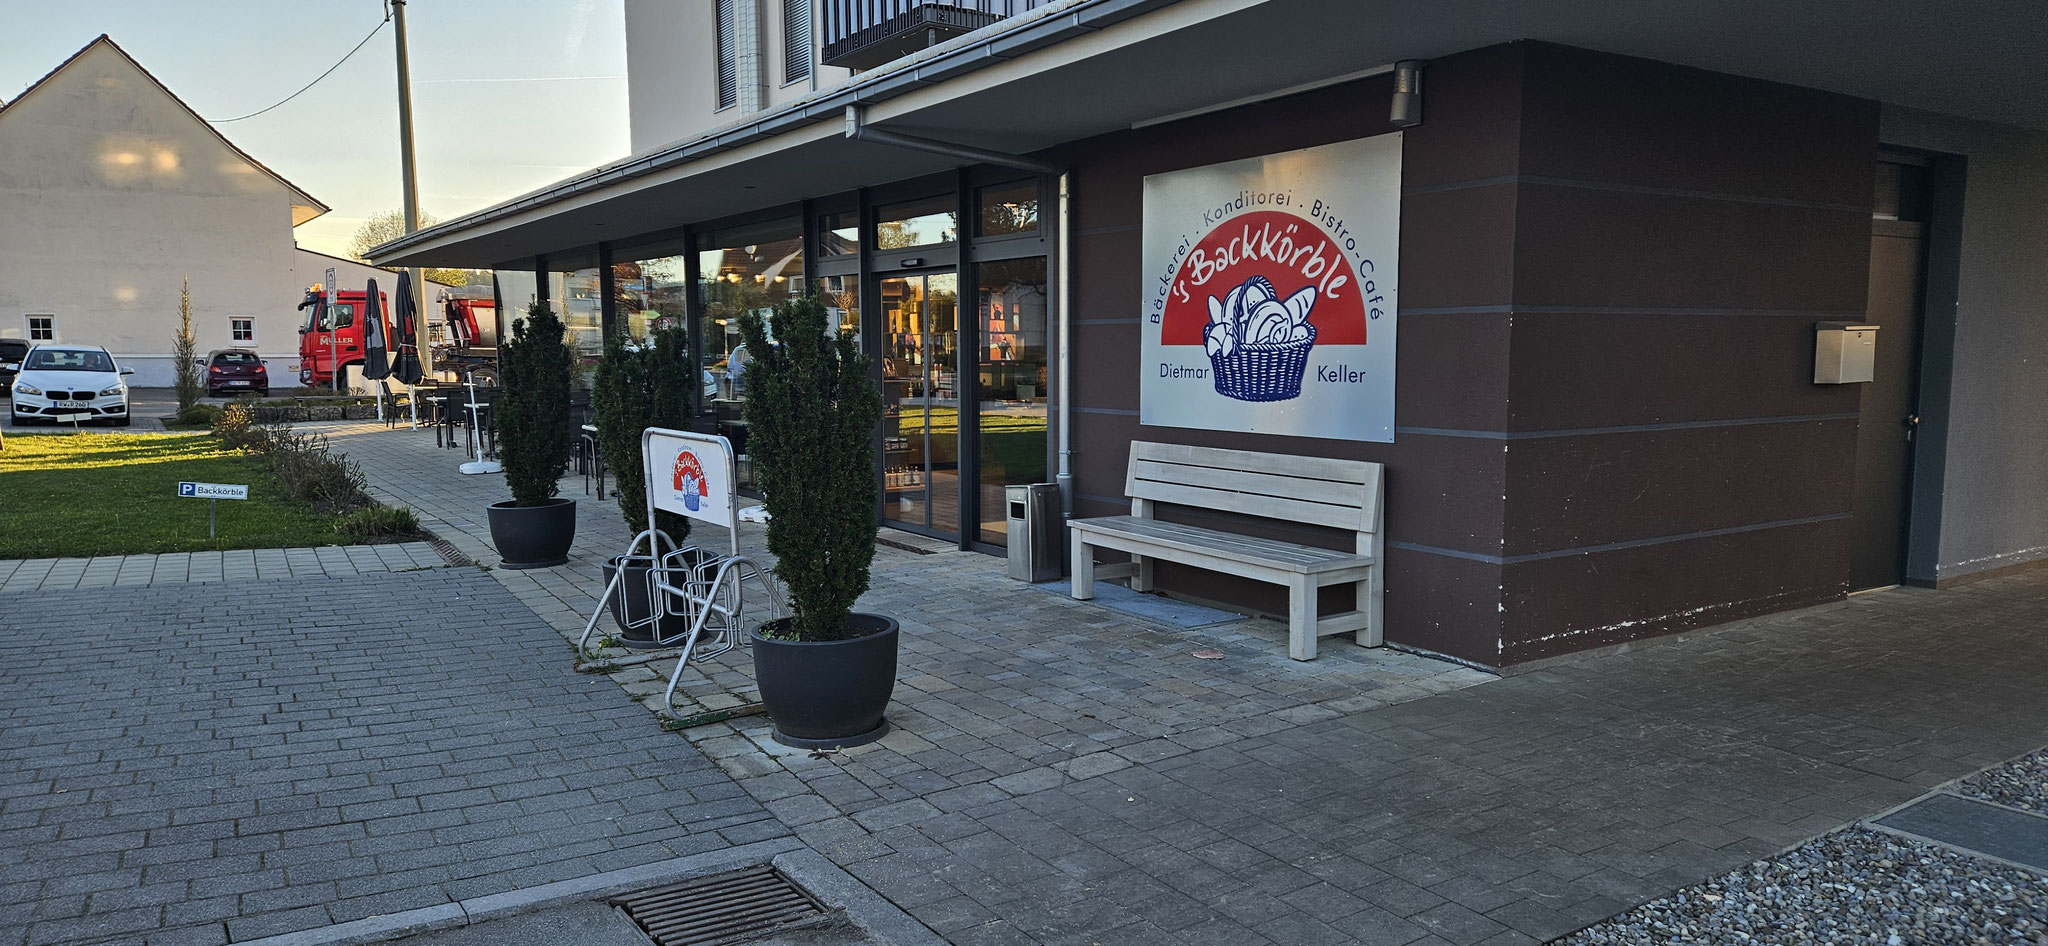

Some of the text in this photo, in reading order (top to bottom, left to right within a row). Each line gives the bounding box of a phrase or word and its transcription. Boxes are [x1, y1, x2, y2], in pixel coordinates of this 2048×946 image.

[1150, 189, 1384, 324] Bäckerei Konditorei Bistro-Café
[1187, 222, 1347, 299] Backkörble
[1160, 363, 1366, 383] Dietmar Keller
[182, 484, 193, 495] P
